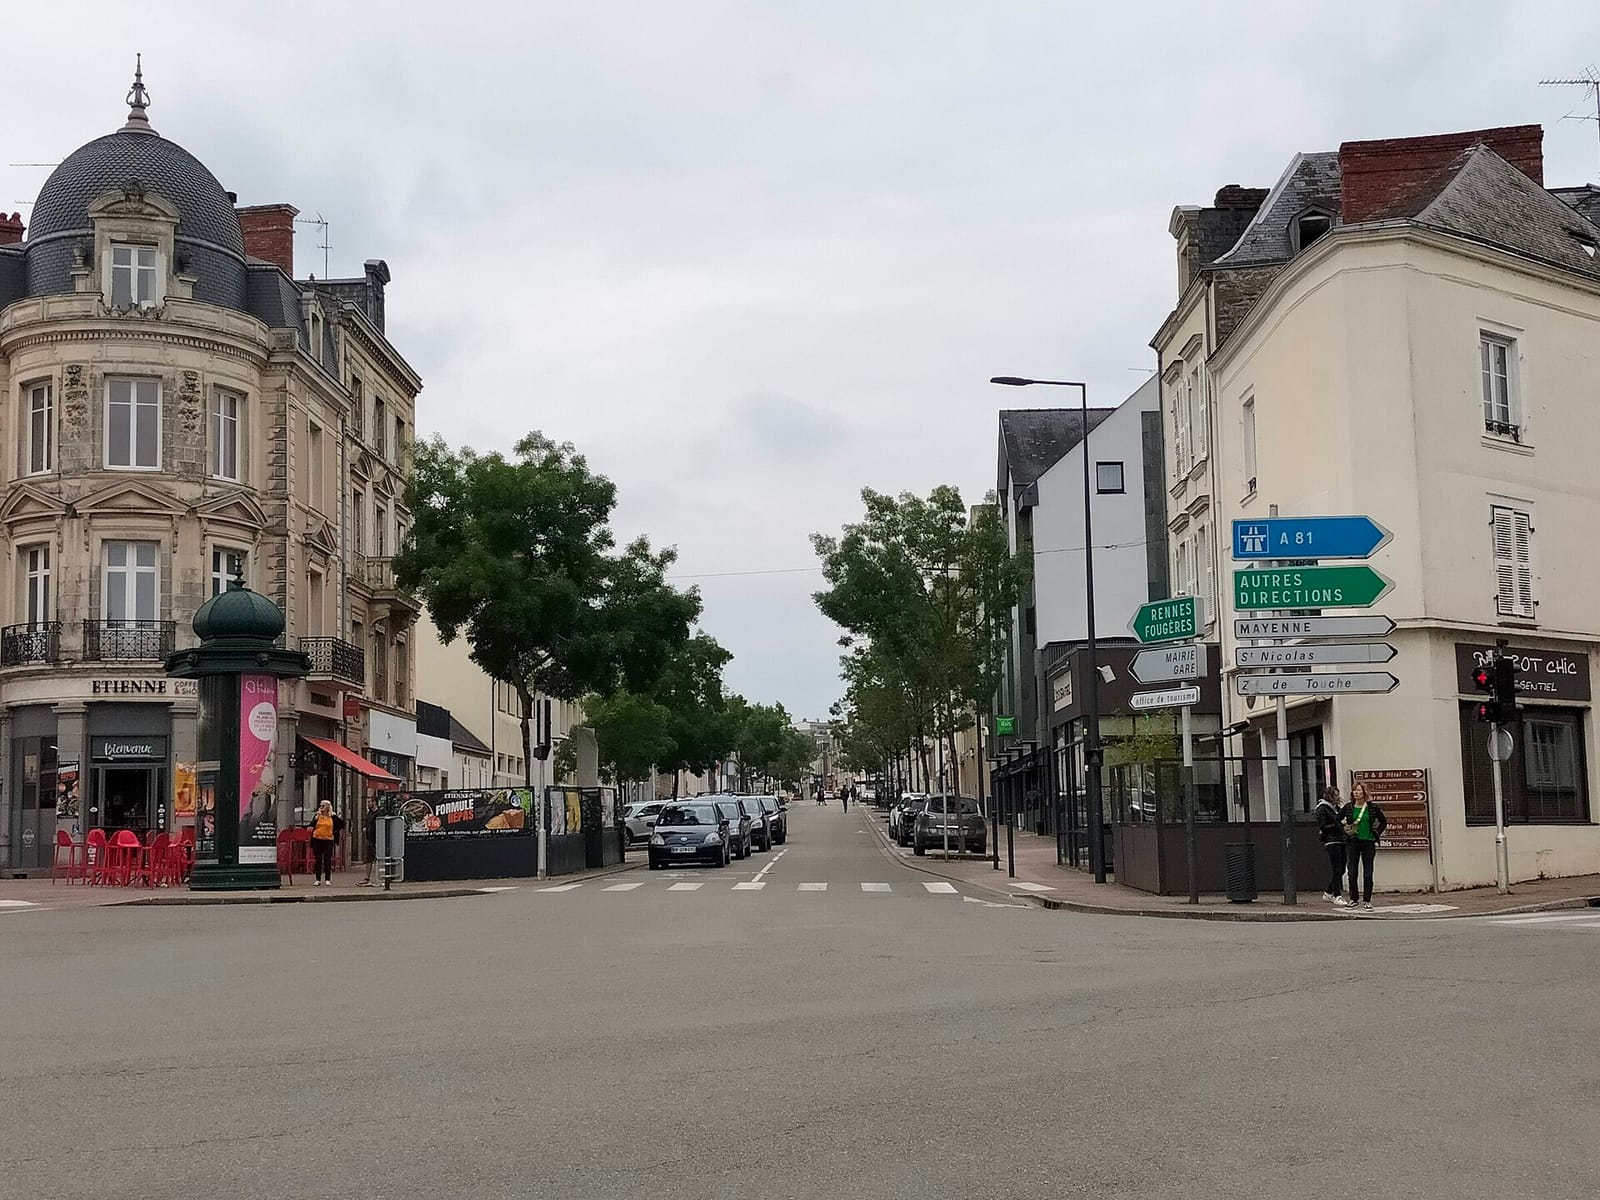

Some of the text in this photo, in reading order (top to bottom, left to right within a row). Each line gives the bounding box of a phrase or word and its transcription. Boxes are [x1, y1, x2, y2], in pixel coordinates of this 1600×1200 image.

[1279, 531, 1313, 545] A 81
[1240, 573, 1303, 588] AUTRES
[1240, 588, 1343, 605] DIRECTIONS
[1151, 602, 1192, 621] RENNES
[1144, 618, 1193, 638] FOUGÈRES
[1240, 622, 1311, 634] MAYENNE
[1165, 650, 1195, 663] MAIRIE
[1260, 650, 1314, 662] Nicolas
[1173, 663, 1196, 675] GARE
[92, 680, 167, 693] ETIENNE
[1272, 678, 1288, 690] de
[1306, 677, 1351, 689] Touche
[1135, 692, 1196, 705] office de tourisme
[104, 742, 153, 757] Bienvenue
[435, 799, 474, 816] FORMULE
[448, 810, 474, 824] REPAS
